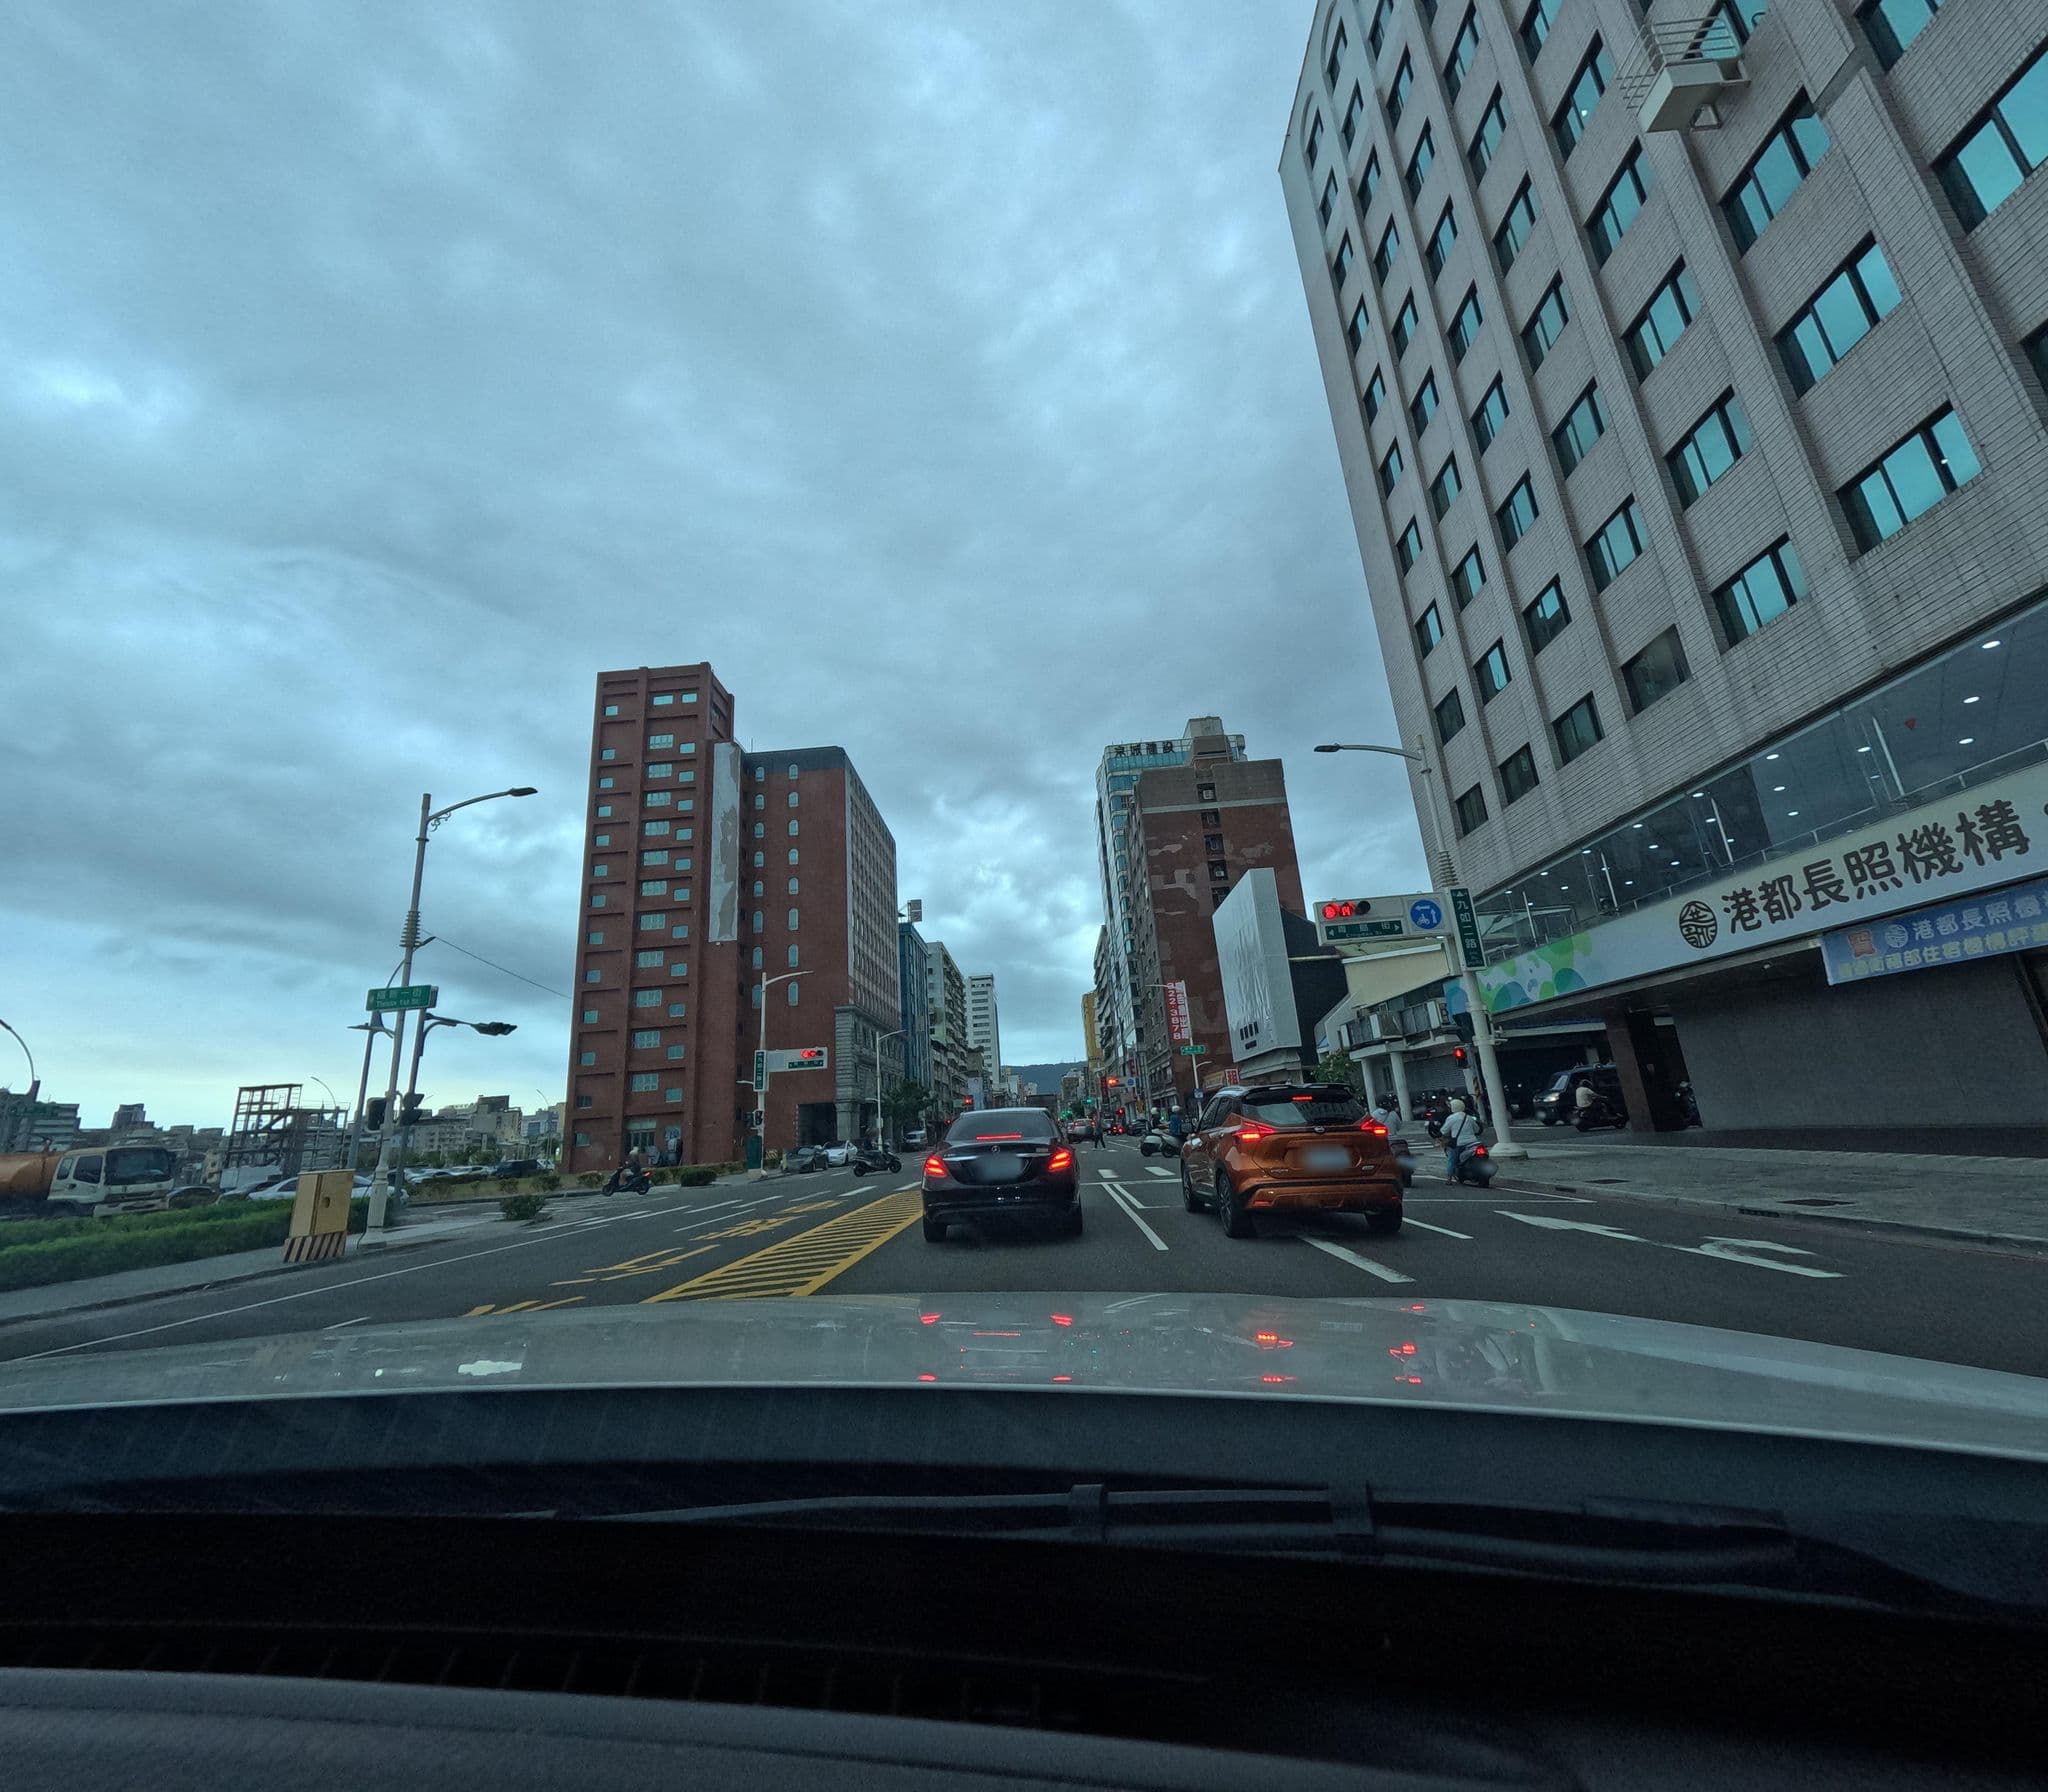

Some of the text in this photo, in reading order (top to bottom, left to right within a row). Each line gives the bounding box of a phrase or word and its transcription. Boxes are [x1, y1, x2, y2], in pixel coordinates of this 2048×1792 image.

[1720, 799, 2031, 935] 港都長照機構
[1457, 900, 1478, 949] 九如二路
[1913, 891, 2048, 941] 港都長照機
